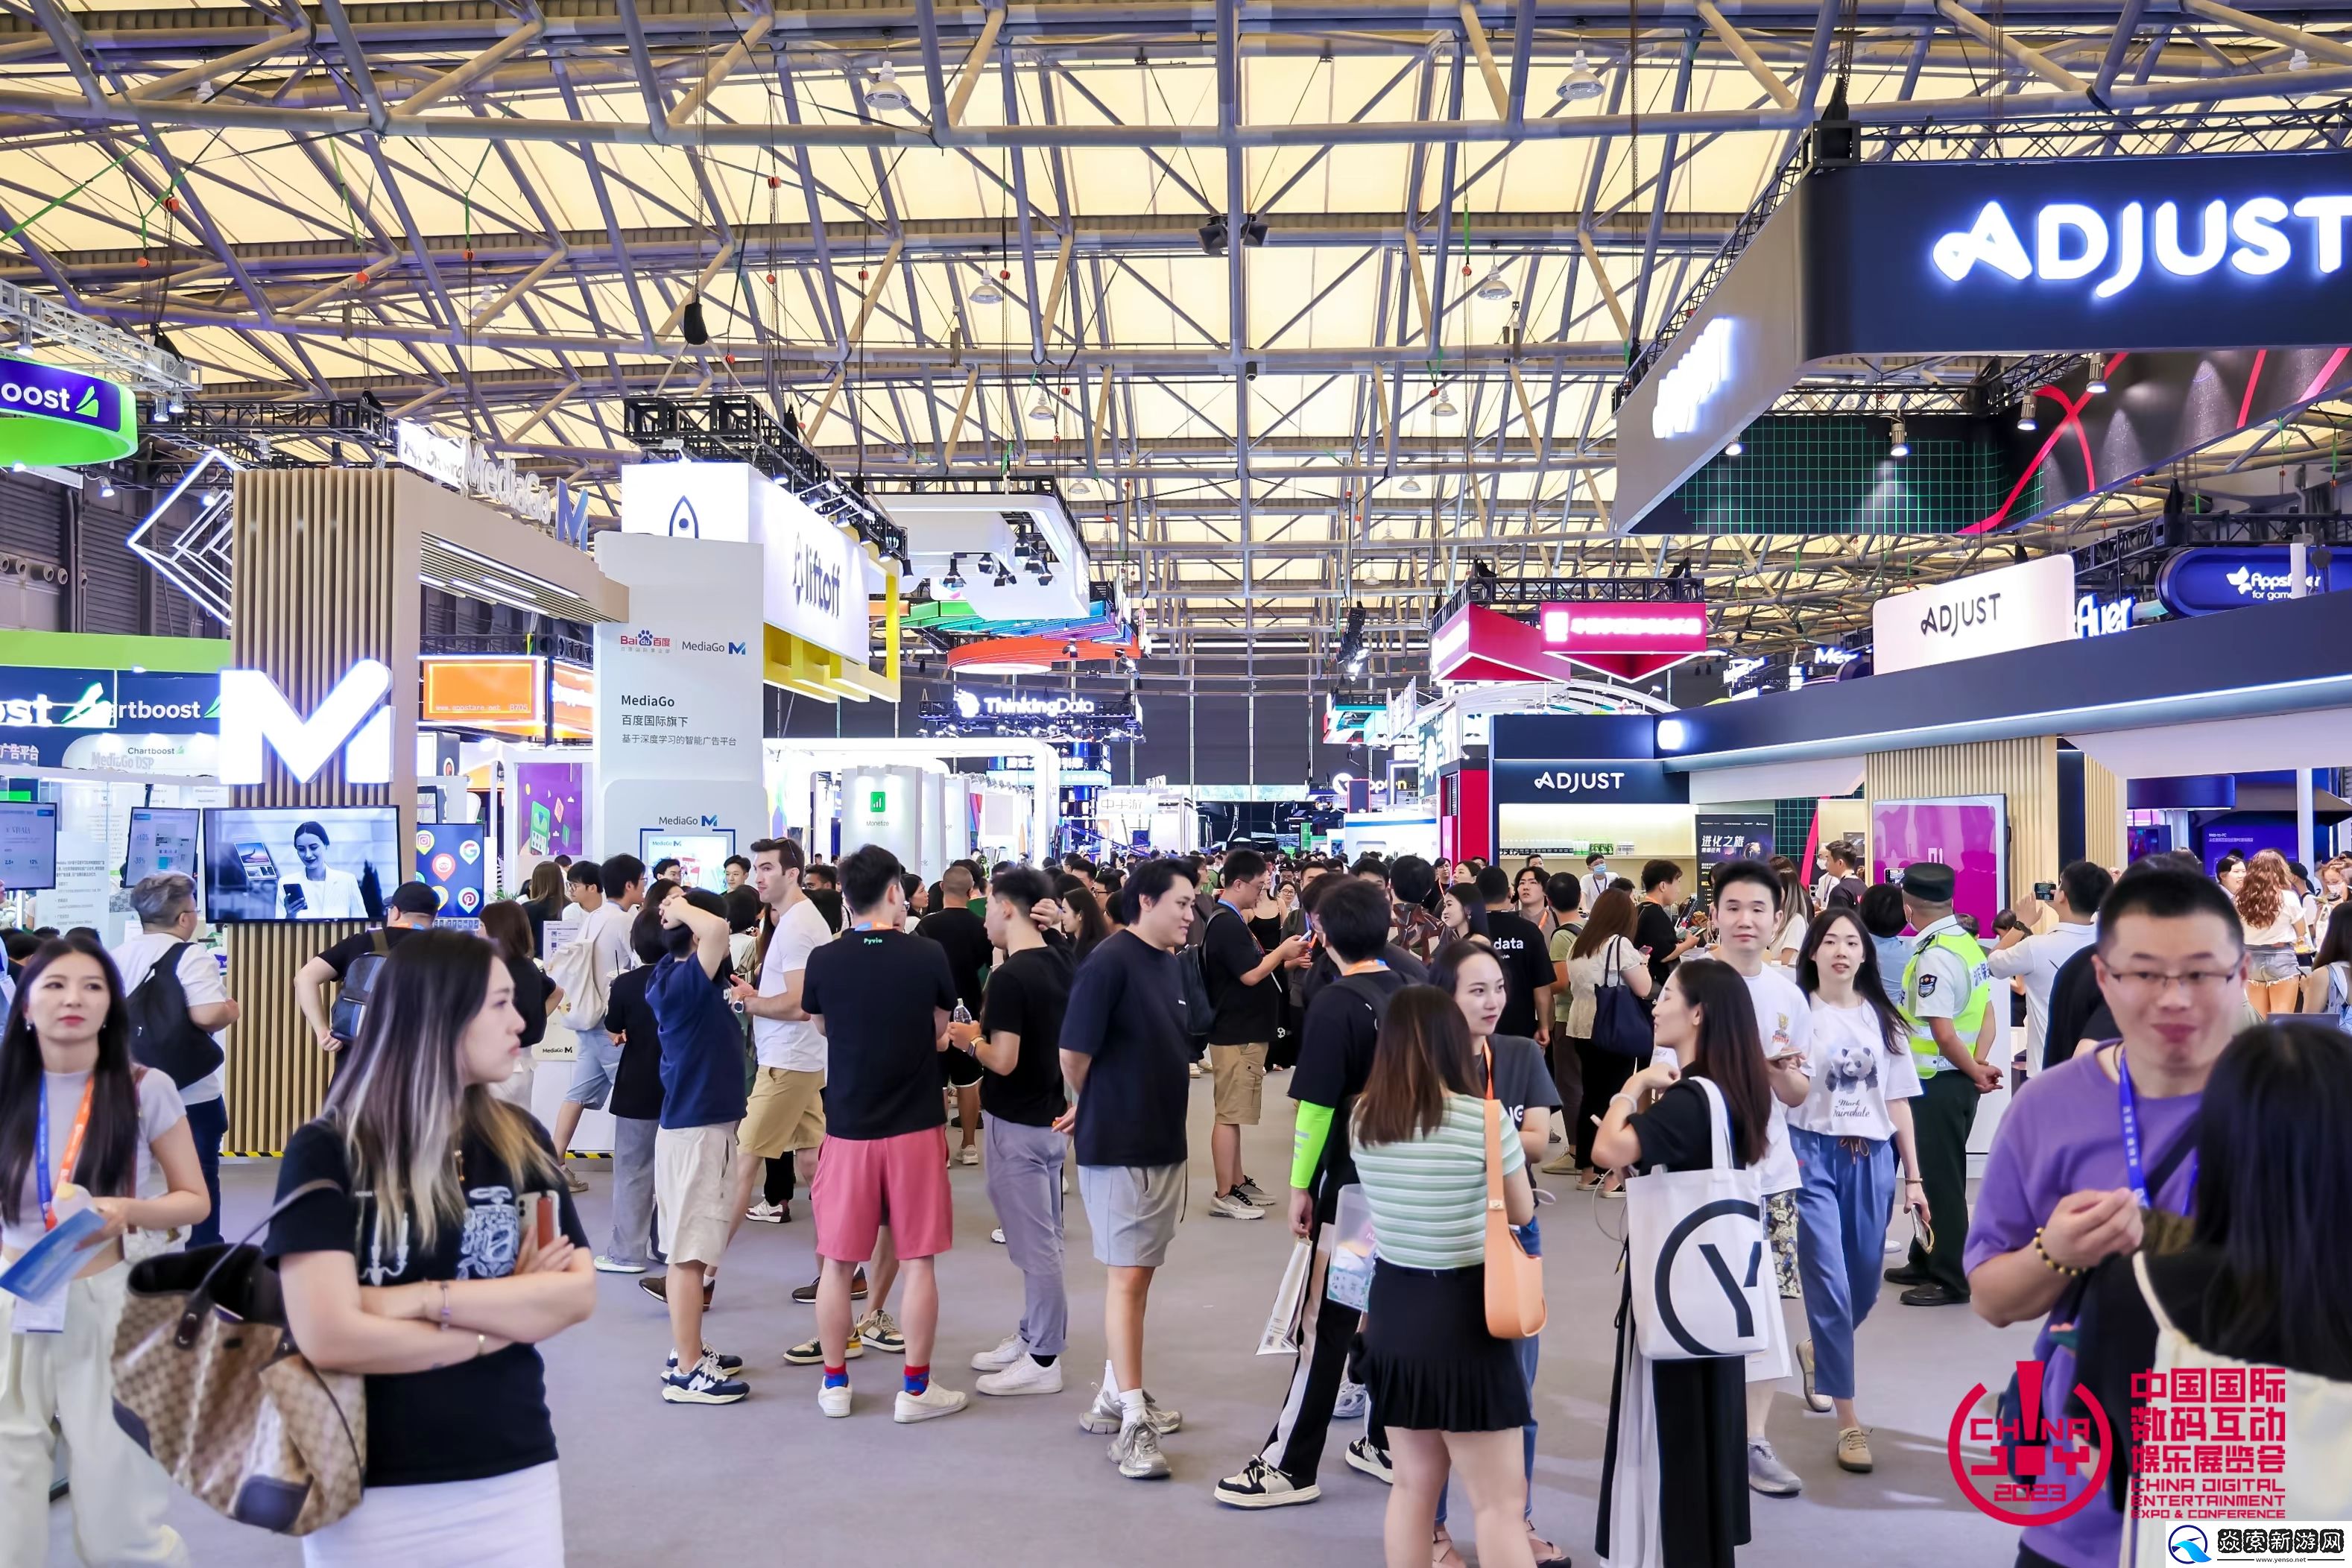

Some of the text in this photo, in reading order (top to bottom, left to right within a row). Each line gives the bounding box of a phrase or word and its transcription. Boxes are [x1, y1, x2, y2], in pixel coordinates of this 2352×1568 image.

[1932, 197, 2352, 297] ADJUST
[805, 544, 840, 619] liftoff
[2252, 590, 2264, 598] for
[1921, 592, 2000, 637] ADJUST
[682, 641, 725, 652] MediaGo
[621, 695, 675, 707] MediaGo
[983, 697, 1095, 717] ThinkingData
[622, 715, 688, 727] 百度国际旗下
[622, 734, 736, 746] 基于深度学习的智能广告平台
[127, 746, 175, 755] Chartboost
[1534, 771, 1625, 794] ADJUST
[659, 816, 698, 825] MediaGo
[1701, 835, 1745, 847] 进化之旅
[1493, 938, 1524, 949] data
